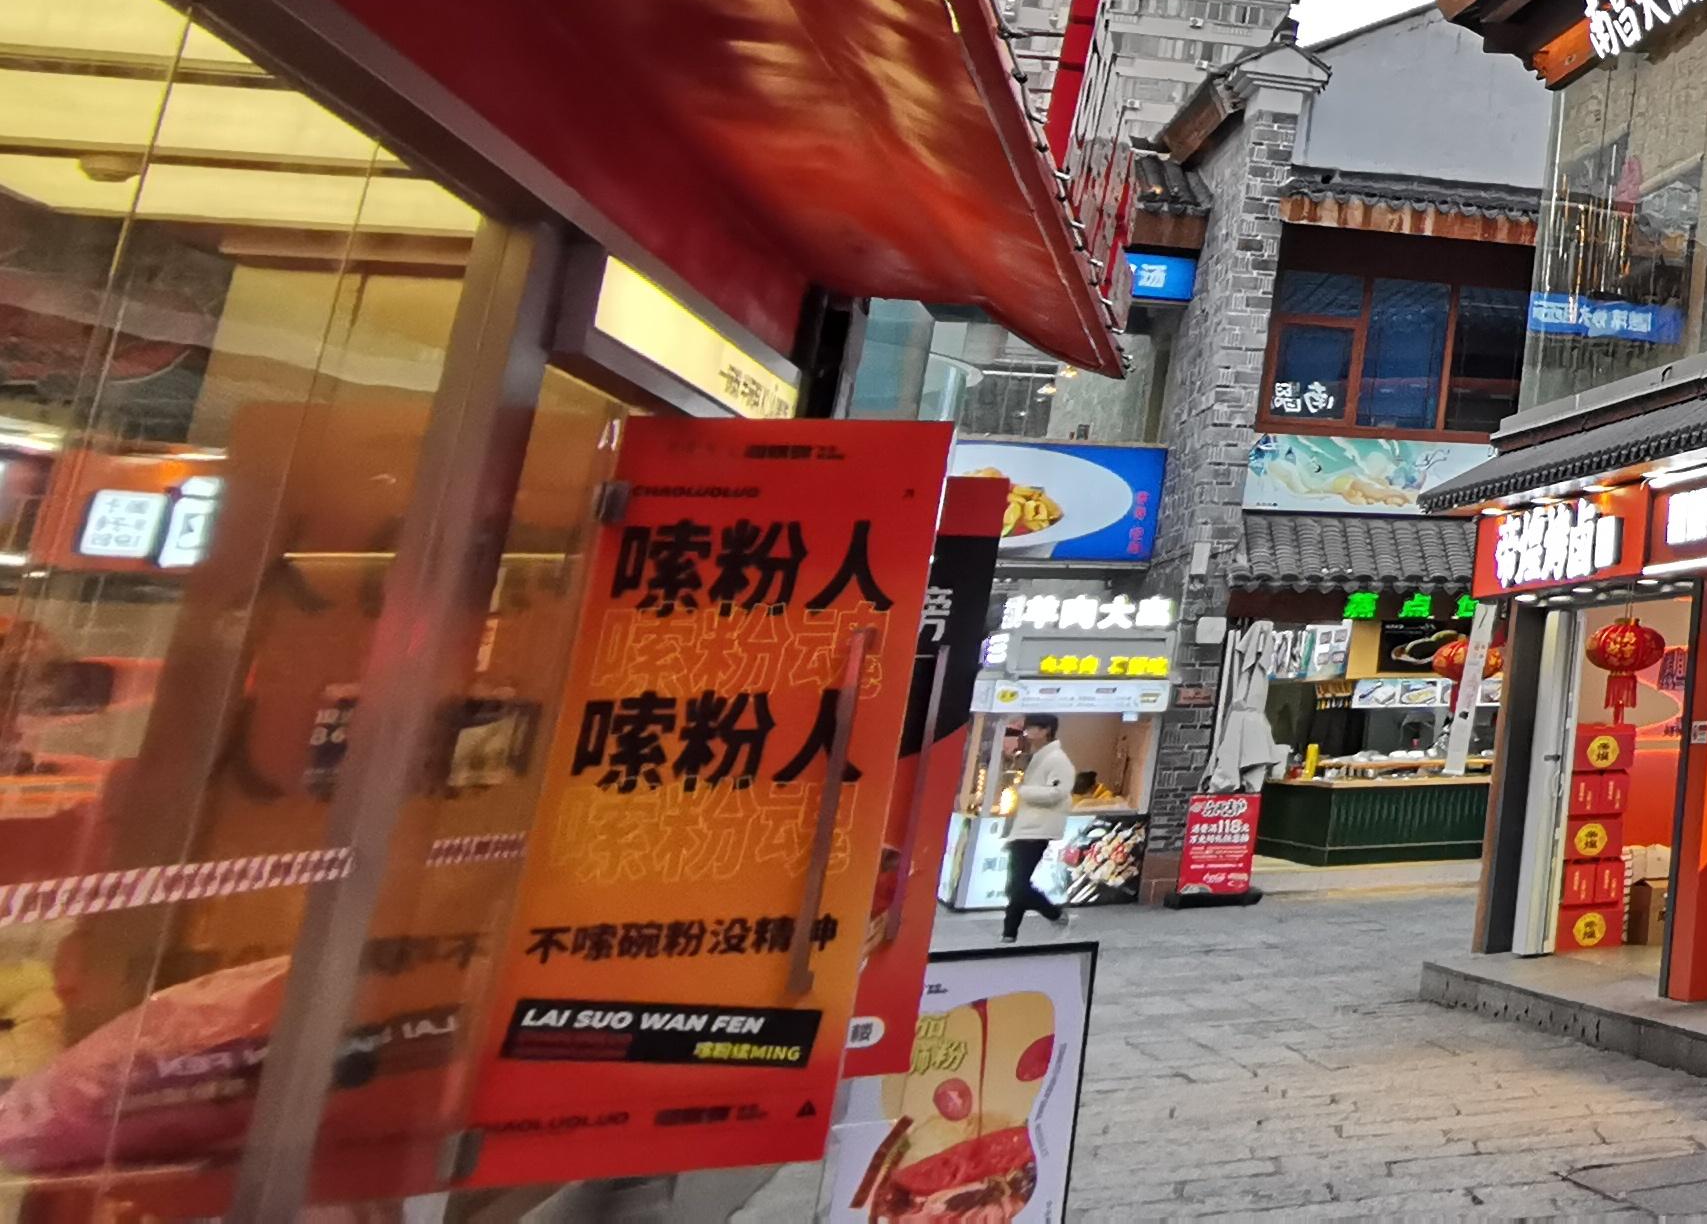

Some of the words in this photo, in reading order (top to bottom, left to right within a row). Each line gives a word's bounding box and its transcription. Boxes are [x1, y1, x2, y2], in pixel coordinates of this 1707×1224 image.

[610, 518, 895, 618] 嗦粉人
[570, 688, 863, 795] 嗦粉人
[520, 1007, 570, 1029] LAI
[572, 1009, 634, 1030] SUO
[639, 1012, 705, 1032] WAN
[709, 1015, 766, 1035] FEN
